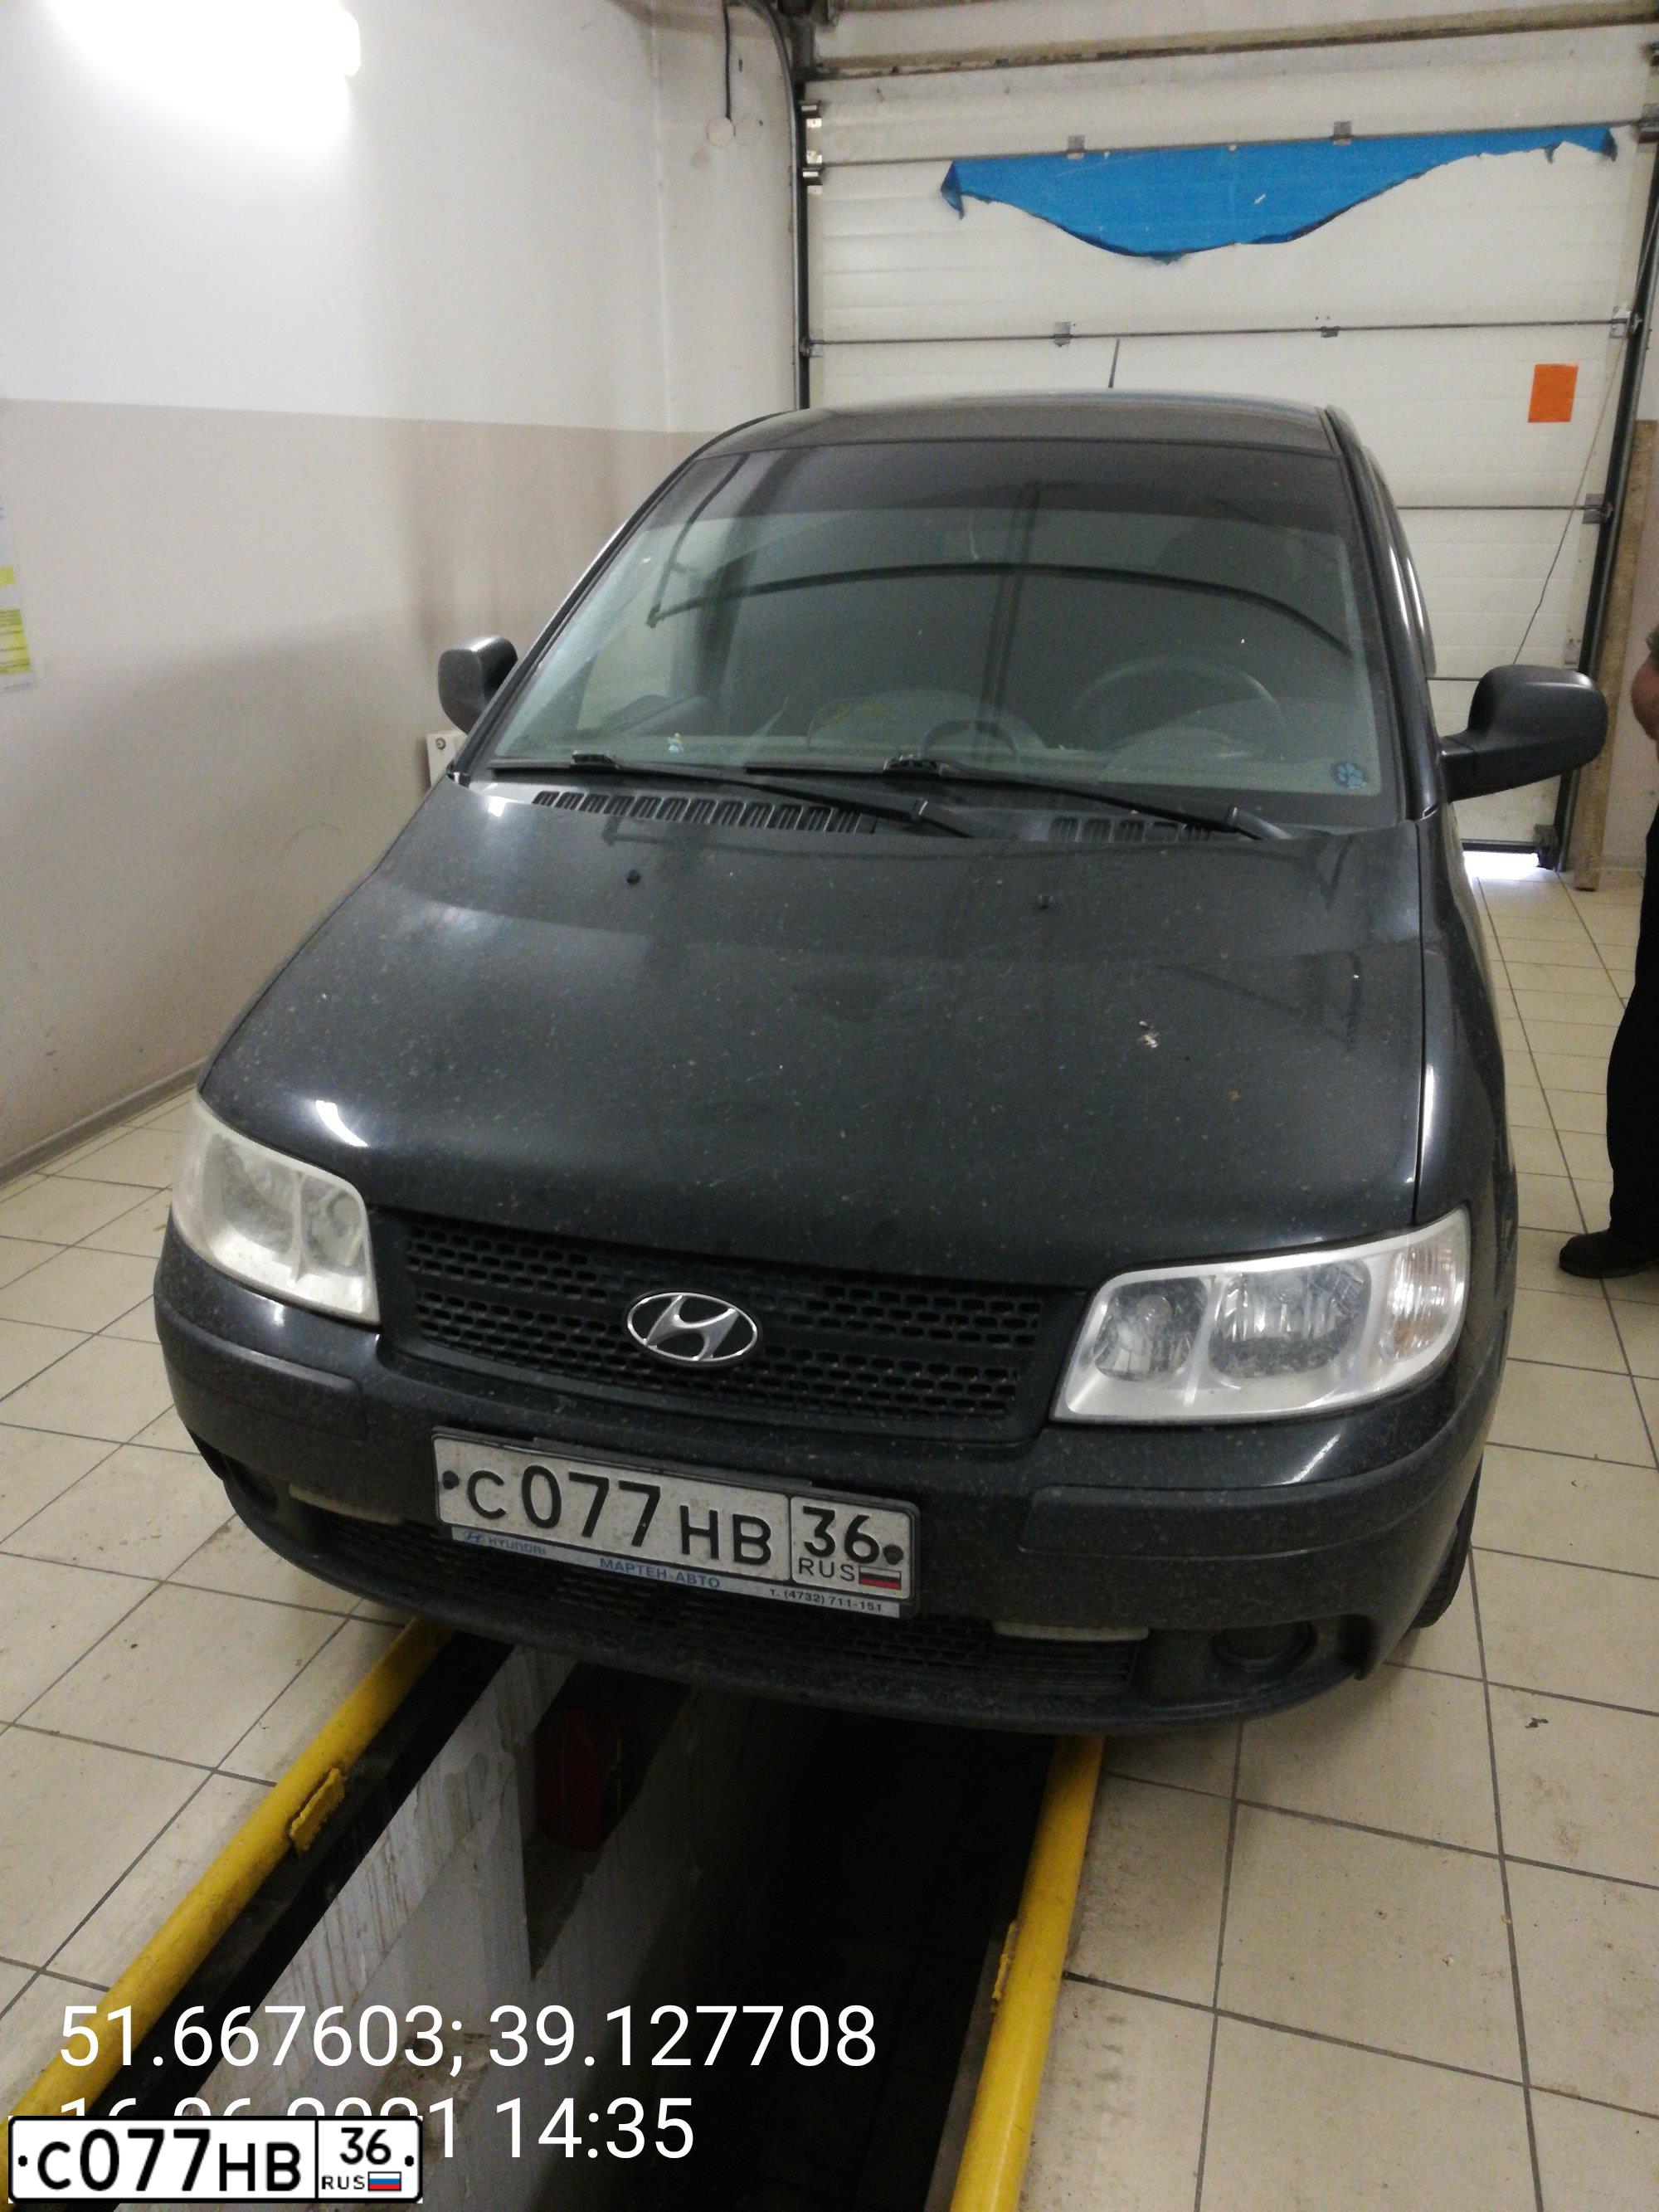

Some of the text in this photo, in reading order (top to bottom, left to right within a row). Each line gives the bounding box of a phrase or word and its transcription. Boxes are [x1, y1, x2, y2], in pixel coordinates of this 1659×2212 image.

[801, 1505, 880, 1564] 36
[798, 1557, 855, 1582] RUS
[784, 1589, 825, 1605] (4732)
[830, 1596, 882, 1612] 711-151
